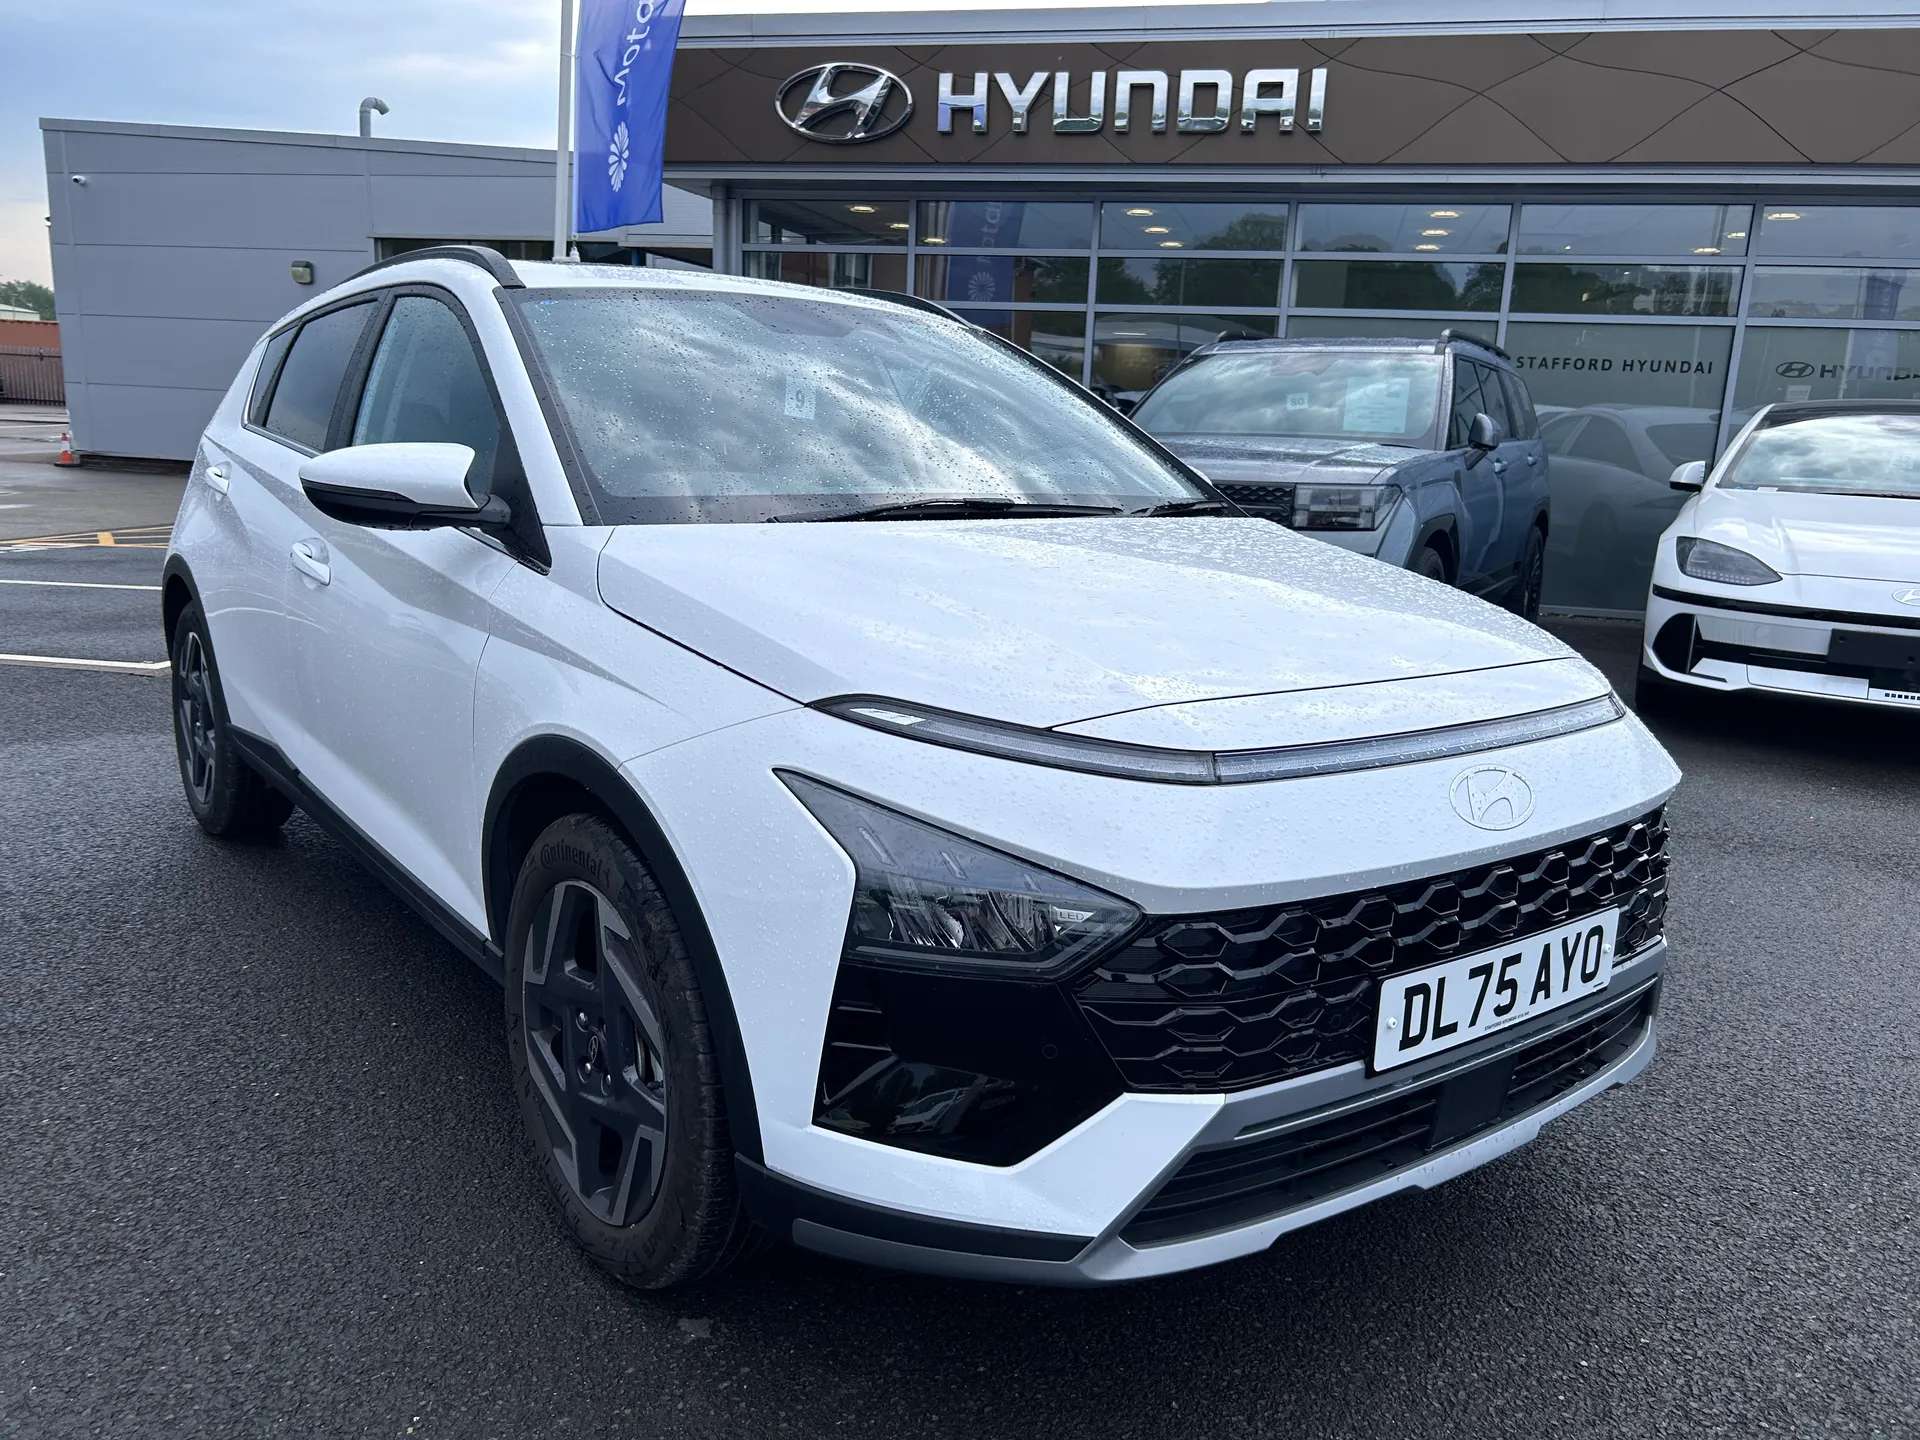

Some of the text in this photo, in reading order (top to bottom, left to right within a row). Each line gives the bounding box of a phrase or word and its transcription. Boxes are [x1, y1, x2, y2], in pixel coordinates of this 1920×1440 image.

[936, 68, 1328, 136] HYUNDAI
[1515, 356, 1713, 375] STAFFORD HYUNDAI
[1060, 911, 1084, 921] LED
[1529, 924, 1604, 1006] AYO
